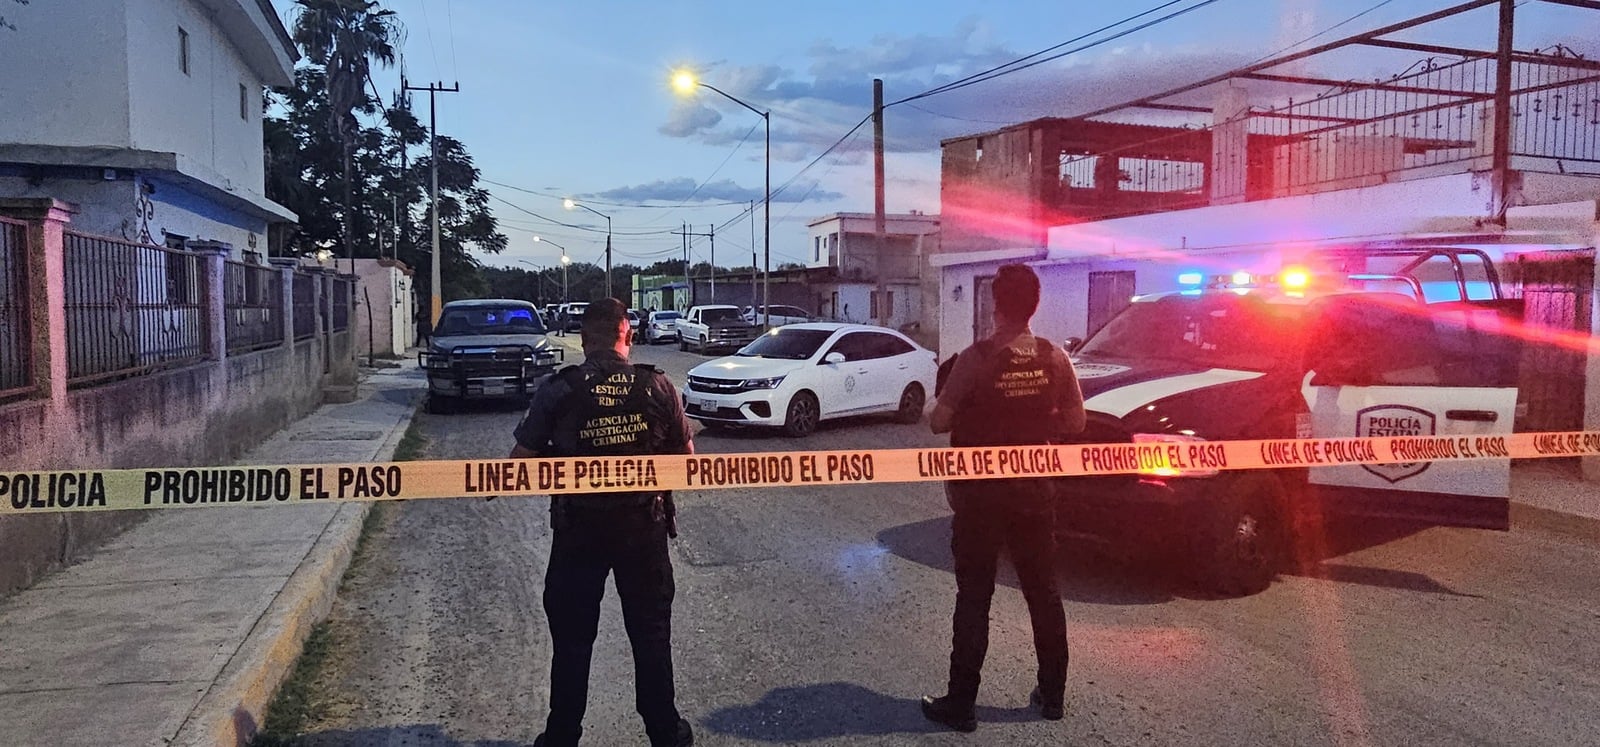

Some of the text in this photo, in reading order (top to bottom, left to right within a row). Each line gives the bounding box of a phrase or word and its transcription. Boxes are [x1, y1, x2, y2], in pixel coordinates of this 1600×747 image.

[586, 413, 642, 428] AGENCIA DE
[1369, 416, 1421, 430] POLICÍA
[580, 422, 648, 439] INVESTIGACIÓN
[593, 433, 637, 447] CRIMINAL
[144, 467, 291, 505] PROHIBIDO
[300, 467, 329, 499] EL
[338, 465, 401, 498] PASO
[465, 462, 531, 493] LINEA
[538, 461, 566, 490] DE
[574, 459, 658, 489] POLICIA
[686, 455, 793, 486] PROHIBIDO
[800, 455, 822, 482] EL
[827, 453, 874, 481] PASO
[918, 450, 967, 477] LINEA
[972, 450, 995, 475] DE
[998, 448, 1063, 474] POLICIA
[1081, 445, 1164, 472] PROHIBIDO
[1168, 445, 1186, 469] EL
[1189, 444, 1227, 468] PASO
[1260, 442, 1303, 465] LINEA
[1302, 441, 1323, 463] DE
[1324, 440, 1378, 463] POLICIA
[1390, 438, 1458, 460] PROHIBIDO
[1458, 437, 1476, 458] EL
[1475, 436, 1509, 457] PASO
[1533, 434, 1569, 454] LINEA
[1567, 434, 1585, 453] DE
